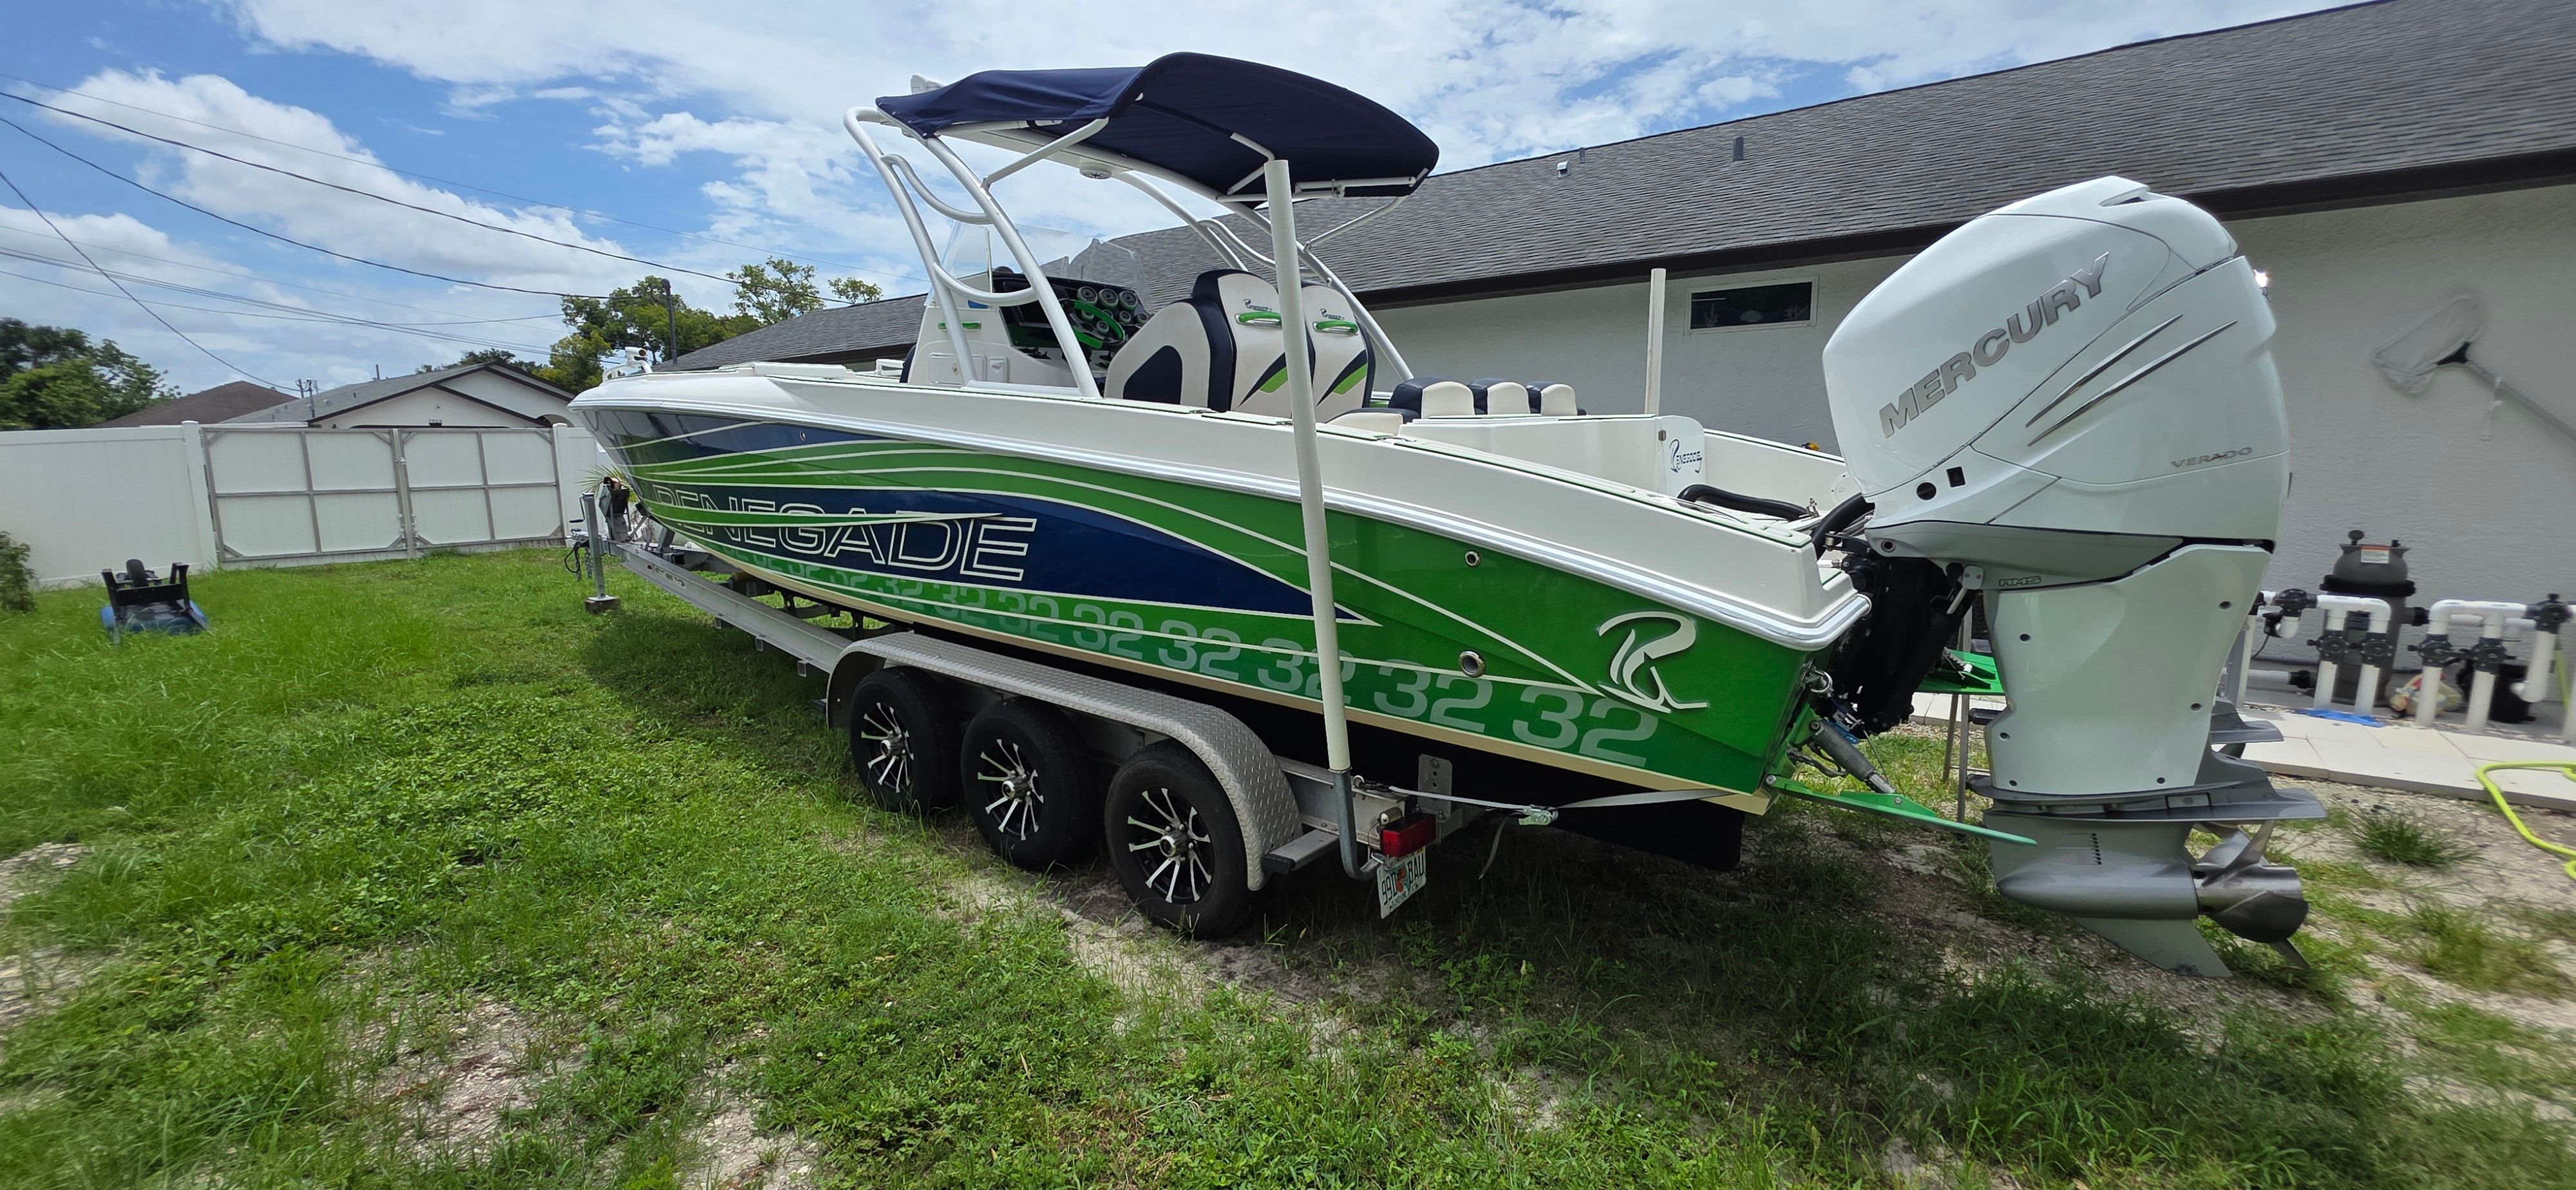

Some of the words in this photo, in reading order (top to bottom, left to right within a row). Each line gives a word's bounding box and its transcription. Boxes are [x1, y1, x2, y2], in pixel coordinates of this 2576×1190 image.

[1878, 251, 2110, 439] MERCURY
[2170, 446, 2253, 468] VERADO
[1999, 576, 2041, 587] AMS
[933, 582, 987, 627] 32
[998, 590, 1061, 643] 32
[1072, 603, 1144, 660] 32
[1158, 619, 1241, 681] 32
[1372, 658, 1493, 733] 32
[1512, 685, 1659, 768] 32
